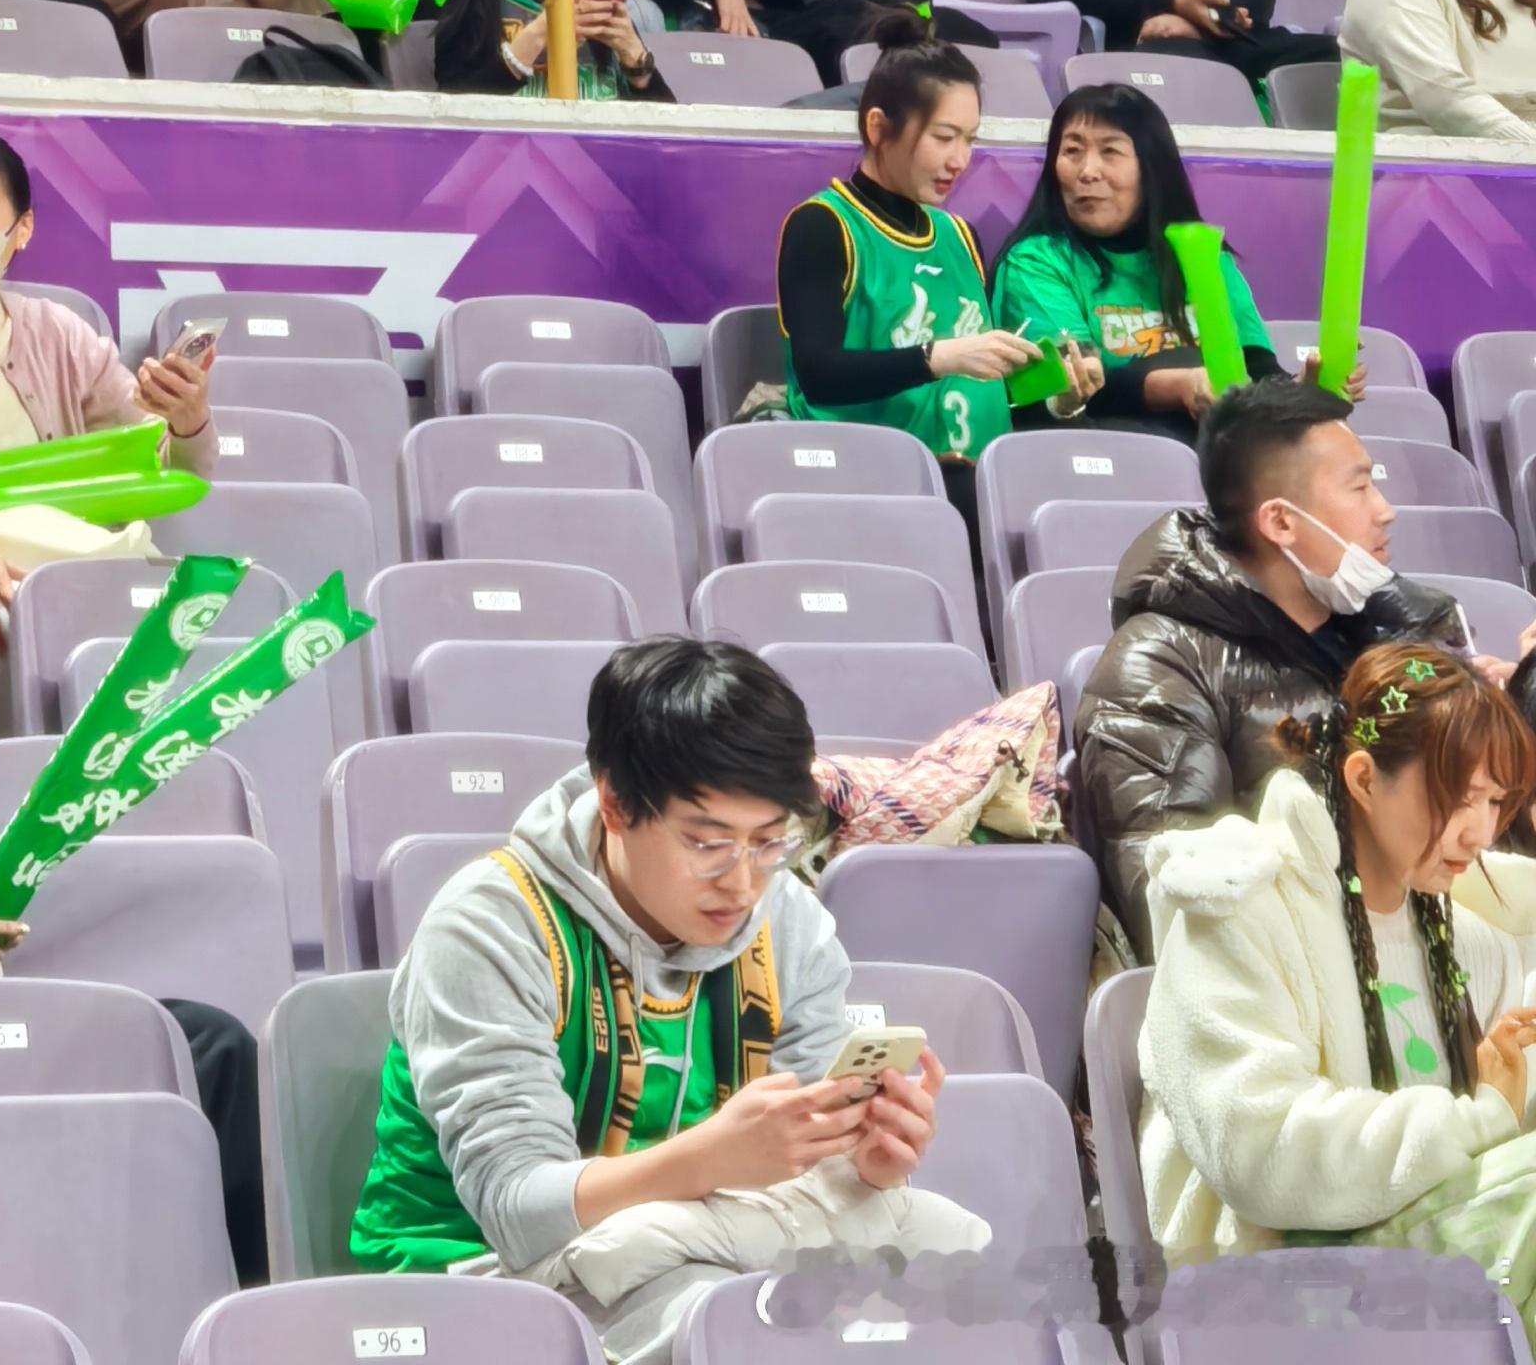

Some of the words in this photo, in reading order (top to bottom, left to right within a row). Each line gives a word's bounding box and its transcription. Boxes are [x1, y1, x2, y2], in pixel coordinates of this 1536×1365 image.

[942, 389, 973, 452] 3
[592, 986, 609, 1054] 2023
[377, 1330, 402, 1354] 96
